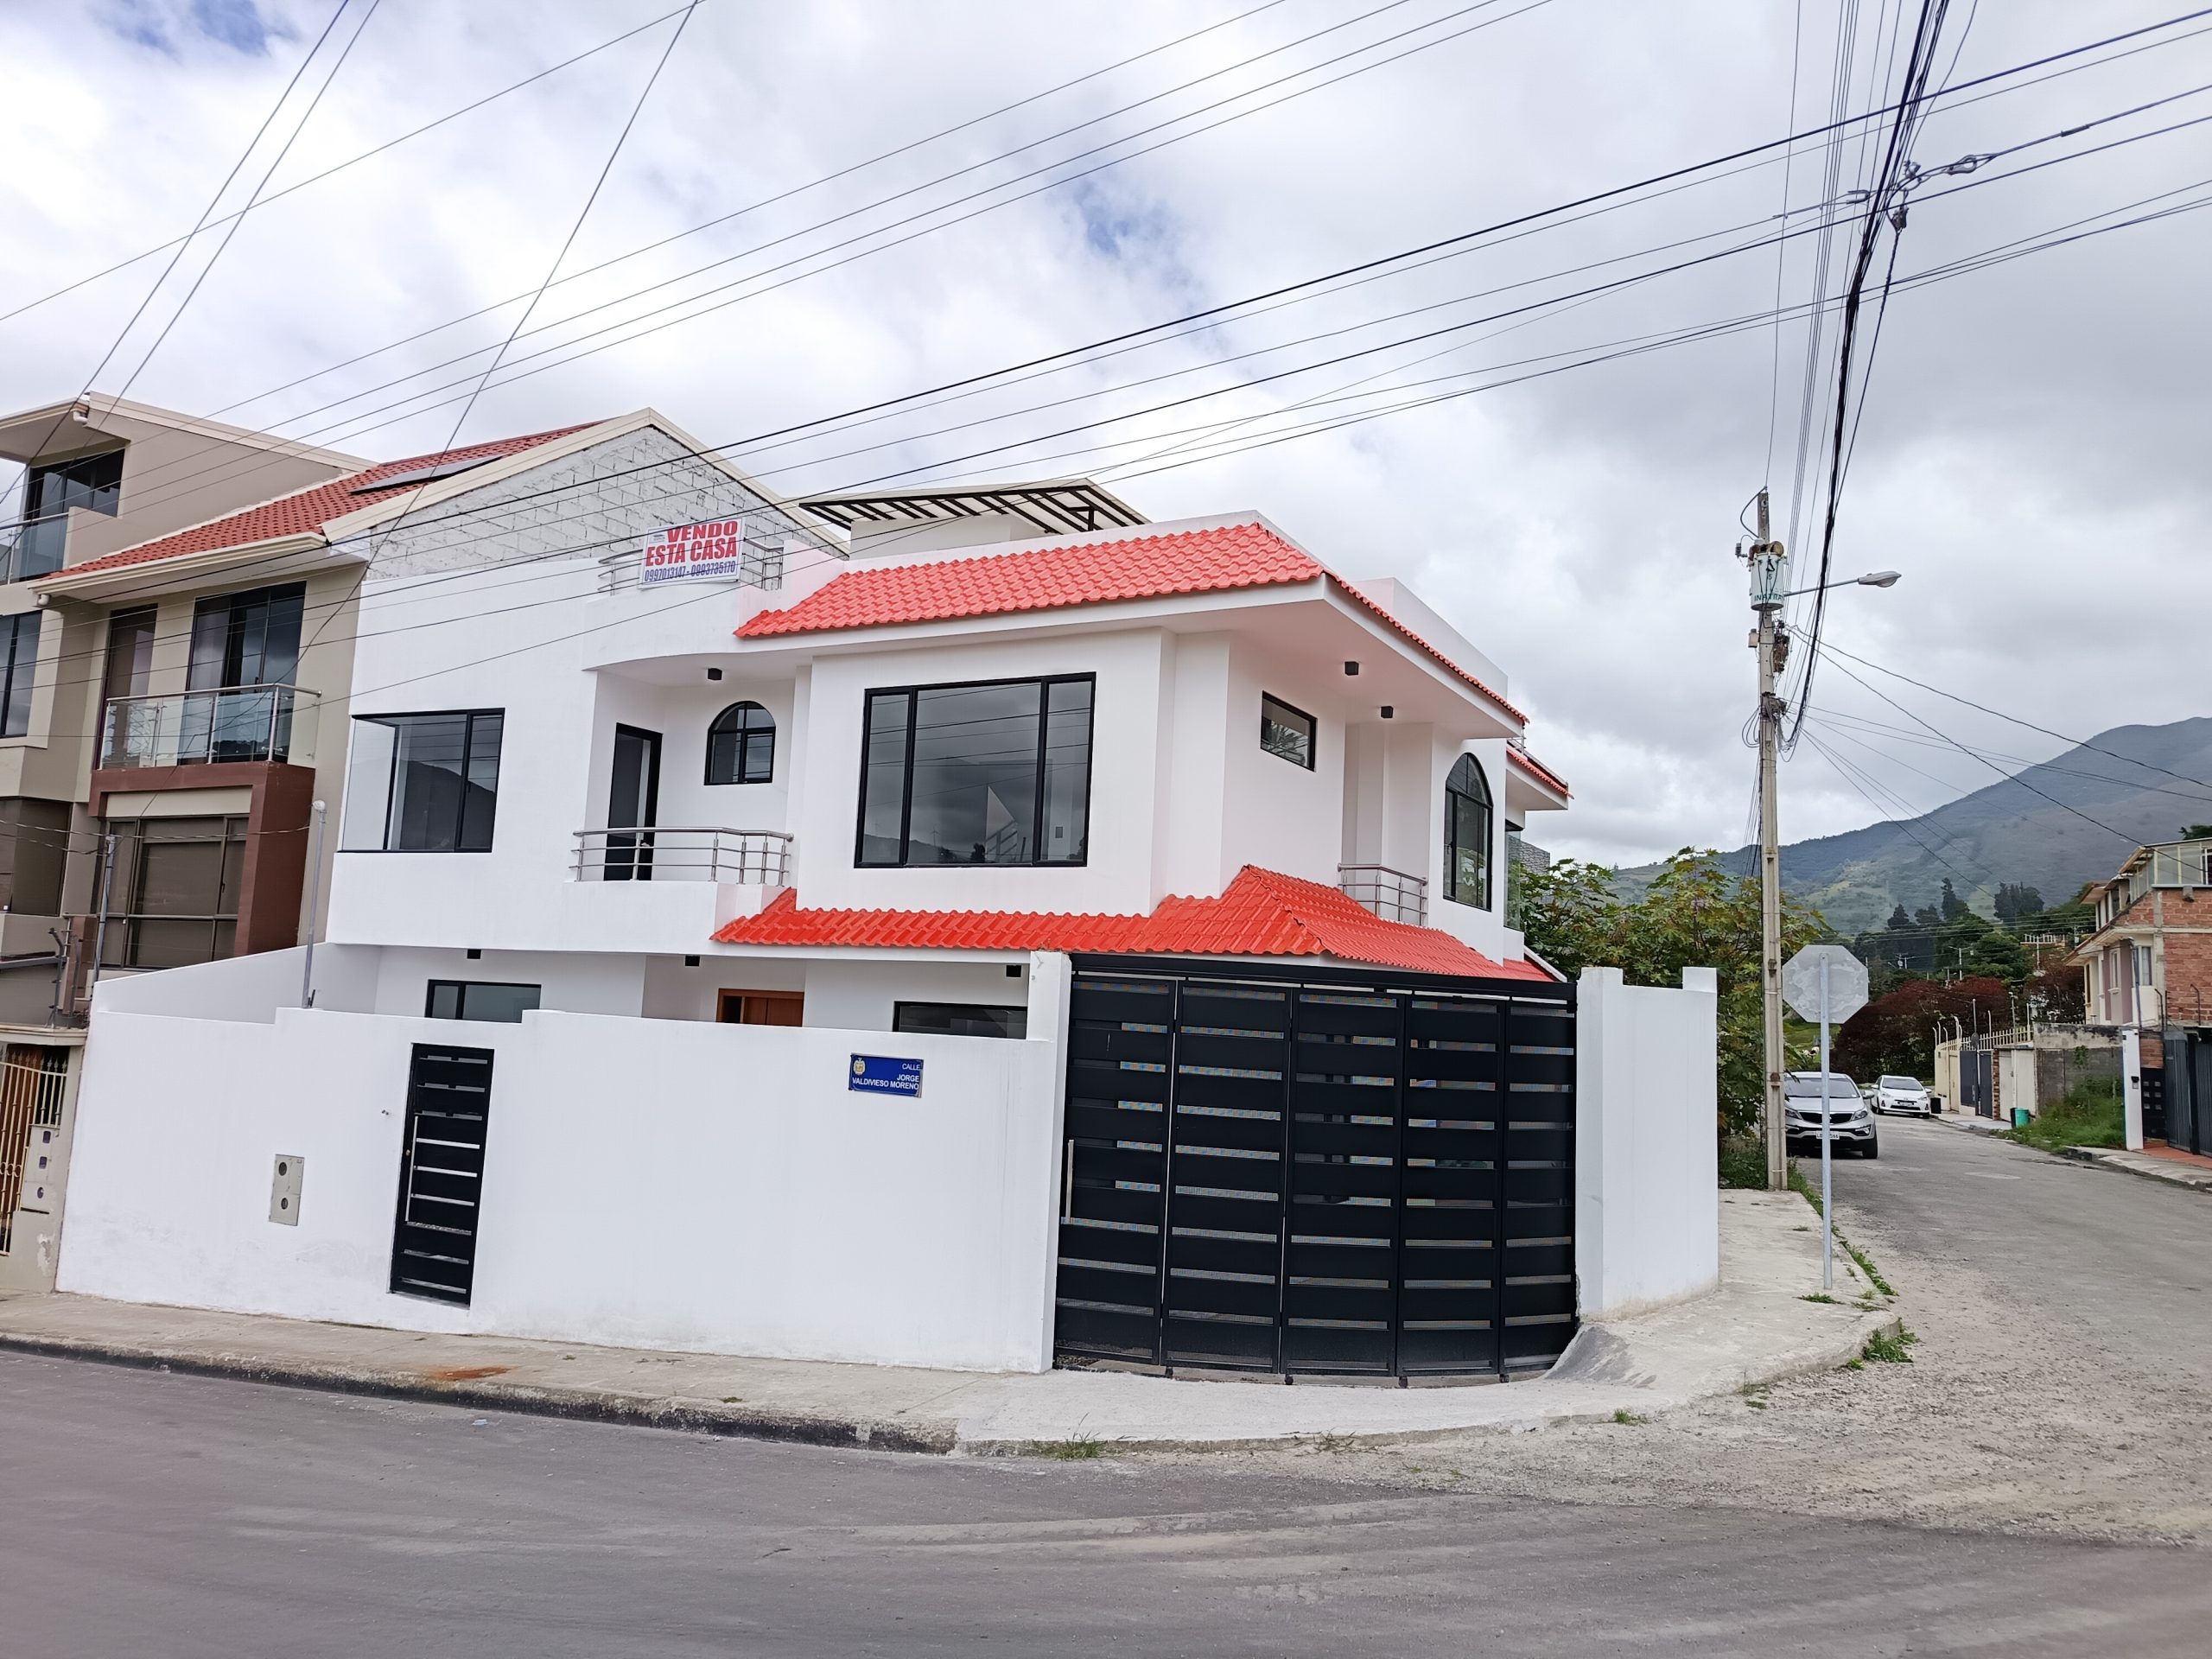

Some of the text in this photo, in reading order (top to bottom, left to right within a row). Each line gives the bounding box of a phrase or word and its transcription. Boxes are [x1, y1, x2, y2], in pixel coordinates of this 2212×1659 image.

[667, 520, 738, 543] VENDO
[645, 537, 736, 567] ESTA CASA
[852, 1077, 919, 1090] VALDIVIESO MORENO
[897, 1074, 919, 1083] JORGE
